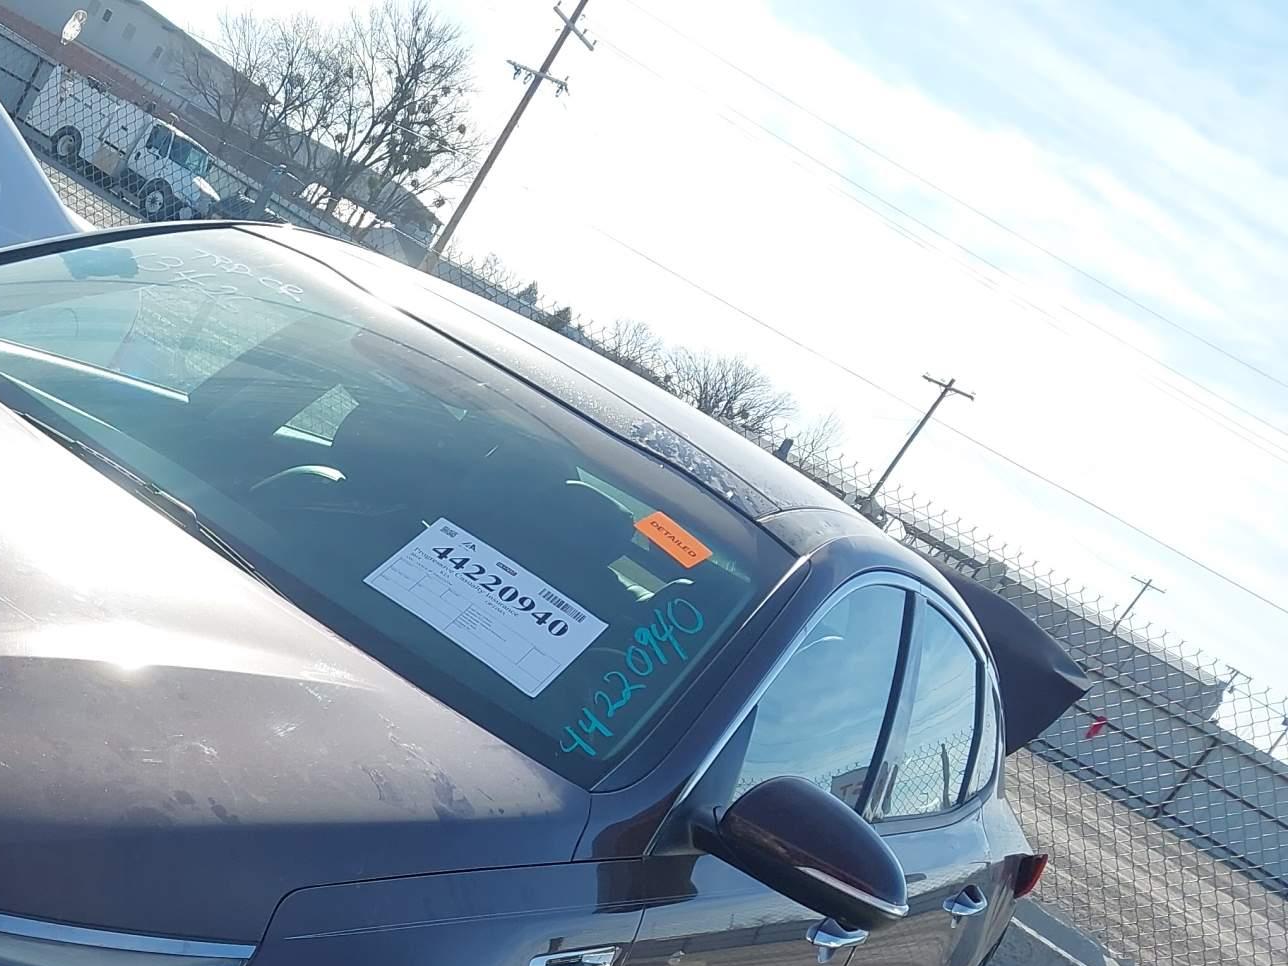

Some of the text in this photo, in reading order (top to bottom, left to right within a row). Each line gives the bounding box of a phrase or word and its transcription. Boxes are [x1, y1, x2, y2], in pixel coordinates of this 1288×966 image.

[650, 520, 697, 558] DETAILED
[431, 546, 569, 637] 44220940
[560, 598, 704, 757] 44220940
